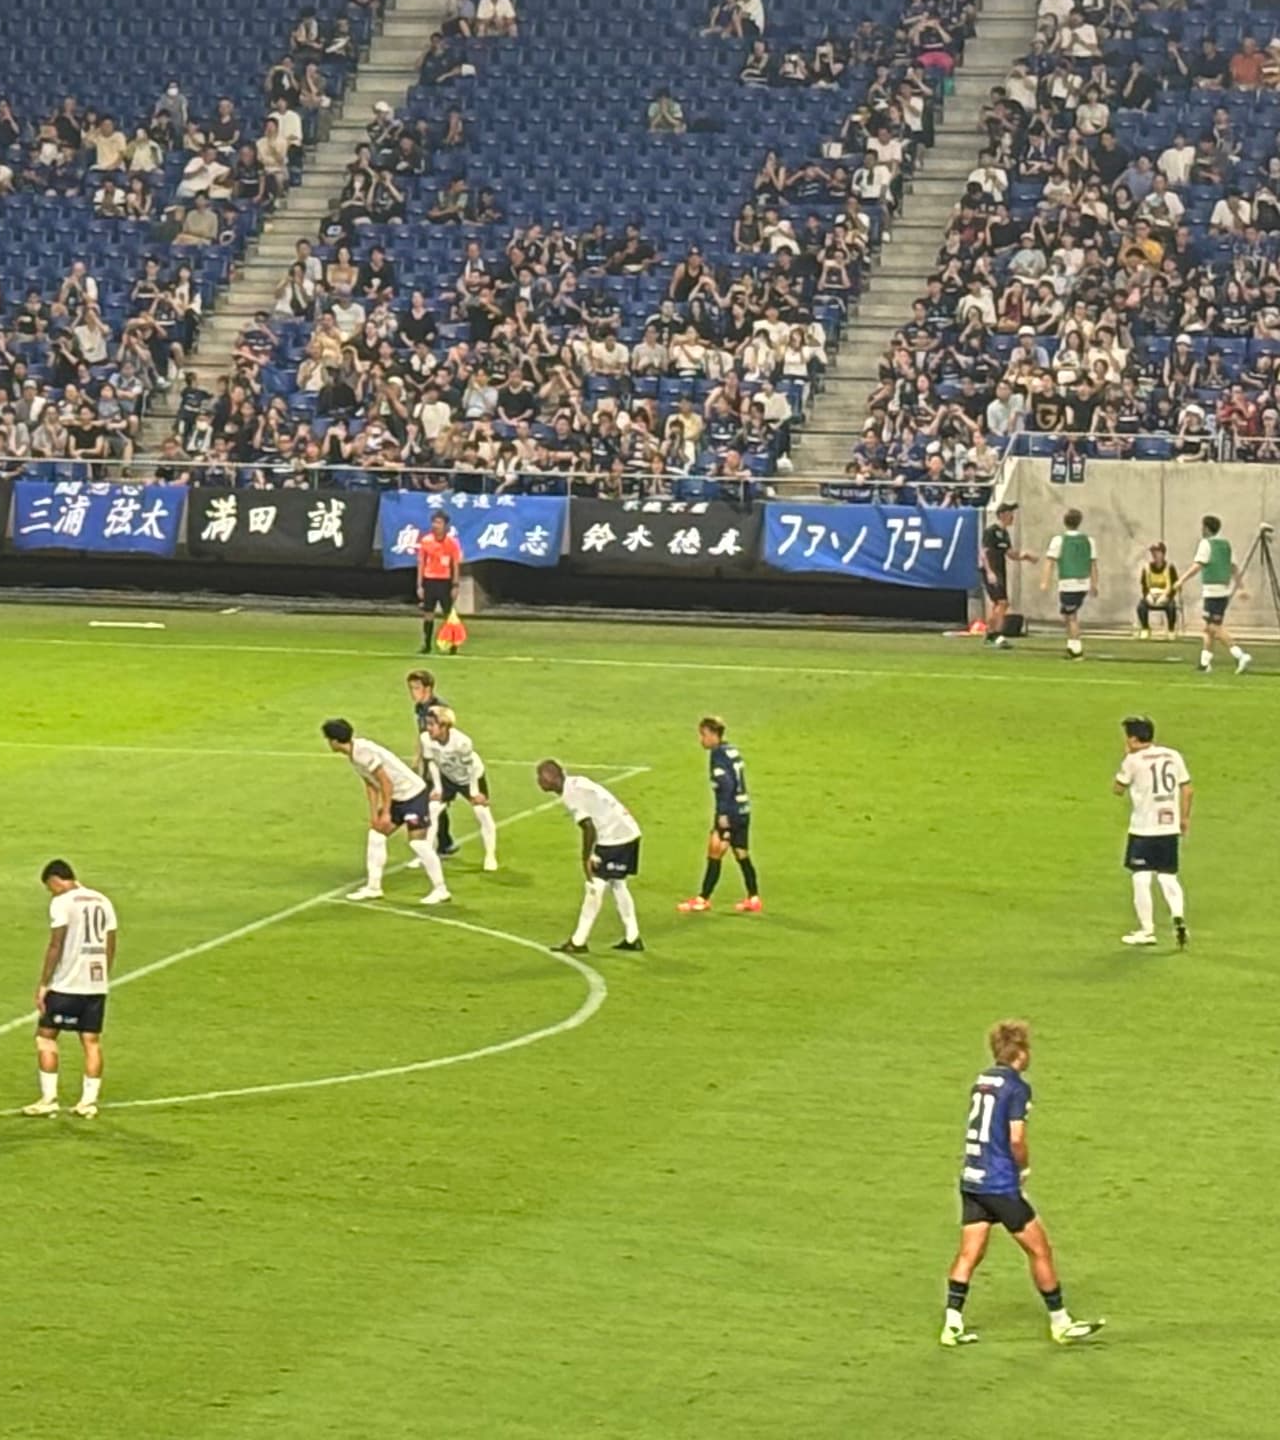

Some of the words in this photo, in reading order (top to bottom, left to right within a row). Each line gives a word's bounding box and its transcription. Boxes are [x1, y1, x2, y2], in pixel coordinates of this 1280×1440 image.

[20, 495, 169, 540] 三浦弦太
[1149, 760, 1176, 794] 16
[82, 906, 106, 943] 10
[965, 1092, 996, 1143] 21
